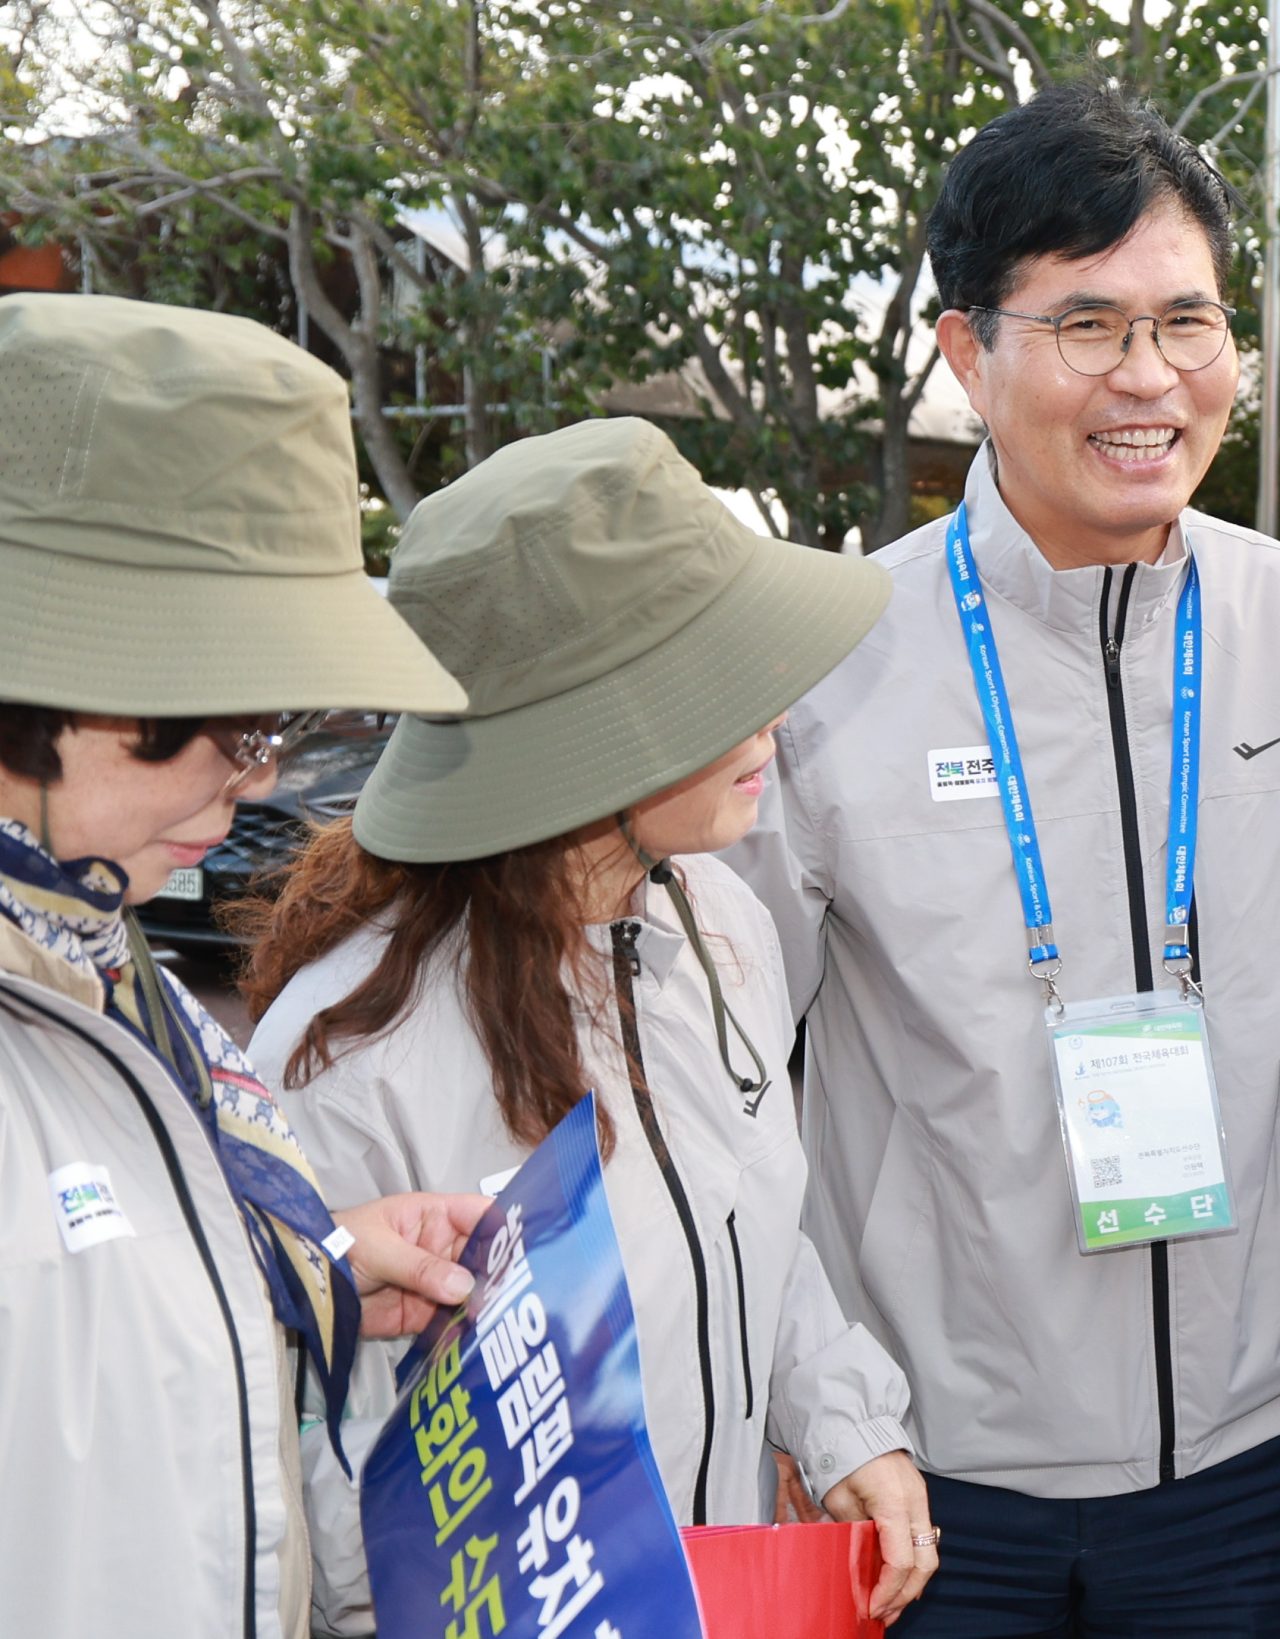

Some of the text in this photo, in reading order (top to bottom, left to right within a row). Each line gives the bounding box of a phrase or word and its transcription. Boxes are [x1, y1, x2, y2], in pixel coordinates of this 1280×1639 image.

[1183, 630, 1194, 675] 대한체육회
[979, 644, 990, 670] Korean
[985, 670, 993, 690] Sport
[992, 695, 1002, 725] Olympic
[998, 724, 1011, 764] Committee
[1183, 711, 1191, 737] Korean
[1182, 737, 1190, 756] Sport
[936, 758, 994, 778] 전북 전주
[1180, 764, 1189, 793] Olympic
[1007, 776, 1024, 822] 대한체육회
[1179, 793, 1189, 834] Committee
[1025, 857, 1034, 884] Korean
[1030, 883, 1039, 903] Sport
[1174, 846, 1187, 892] 대한체육회
[1091, 1045, 1190, 1070] 제107회 전국체육대회
